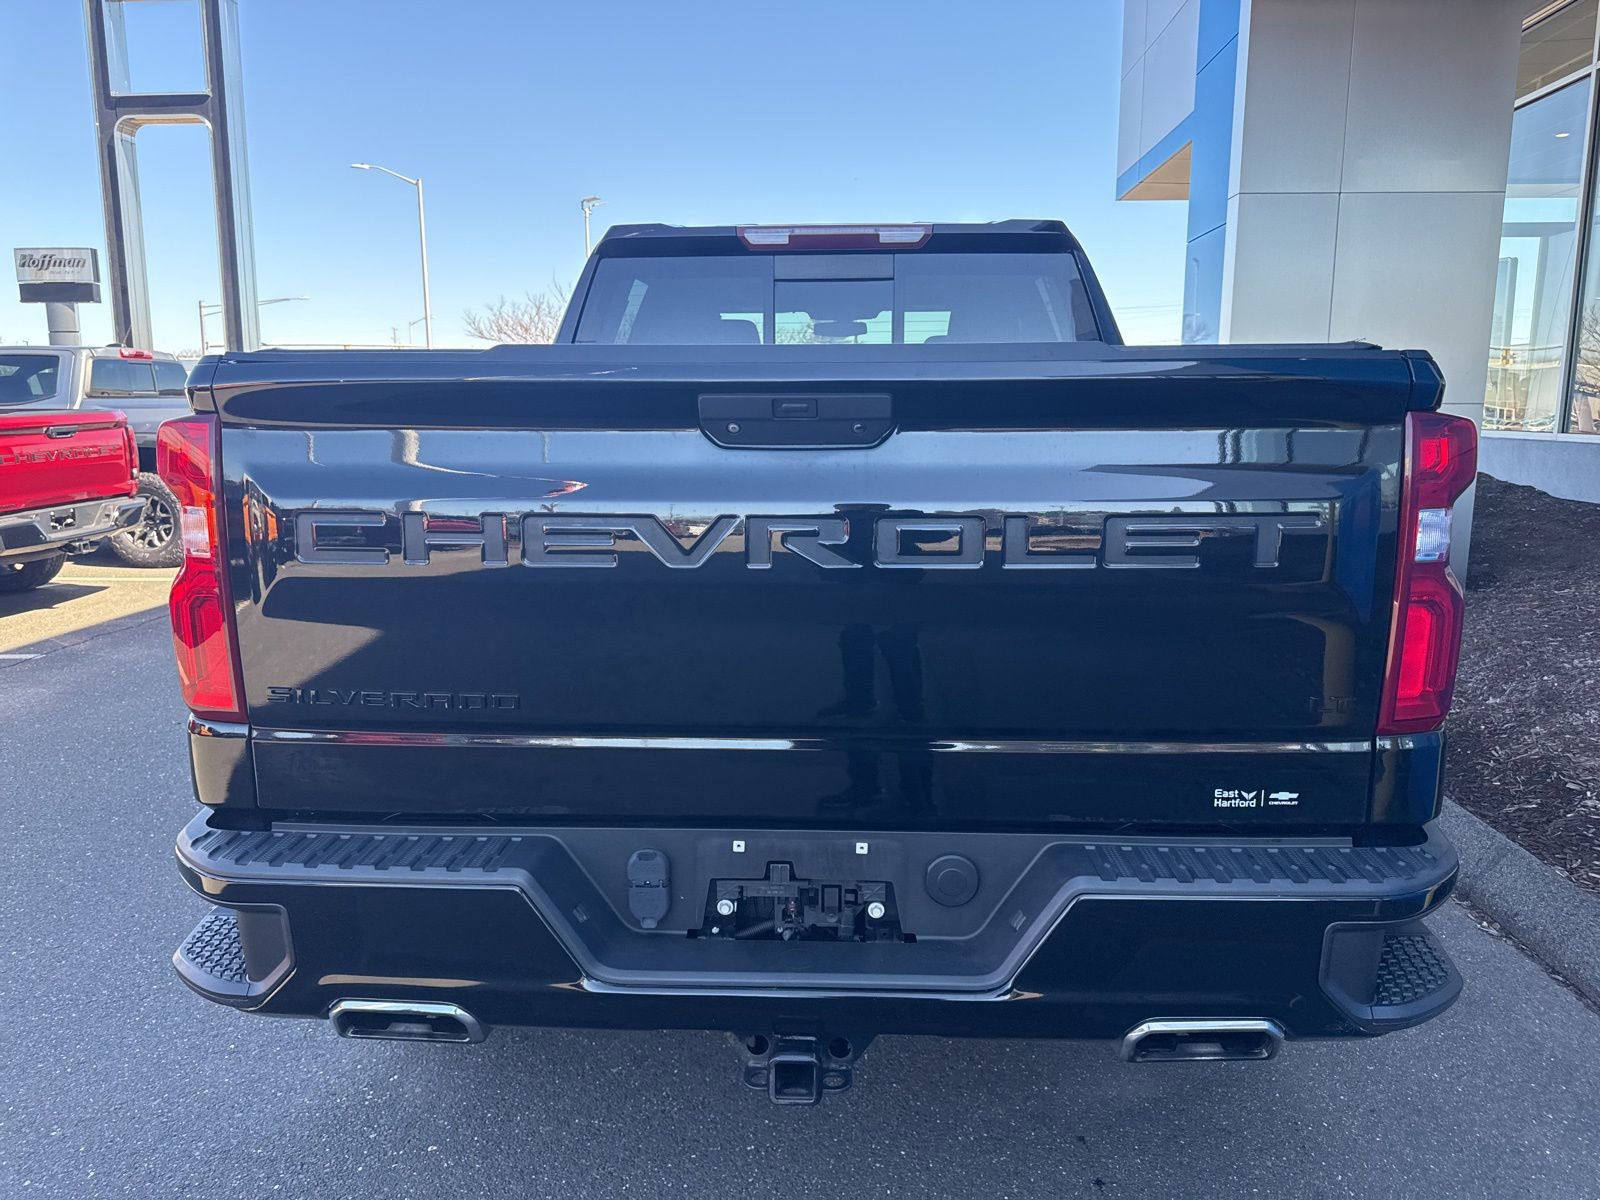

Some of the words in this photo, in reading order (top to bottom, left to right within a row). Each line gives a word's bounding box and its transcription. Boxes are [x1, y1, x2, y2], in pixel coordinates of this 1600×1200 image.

[18, 253, 87, 271] Hoffman
[0, 444, 122, 465] CHEVROLET
[294, 507, 1322, 570] CHEVROLET
[266, 685, 520, 710] SILVERADO
[1214, 788, 1239, 798] East
[1214, 798, 1256, 808] Hartford
